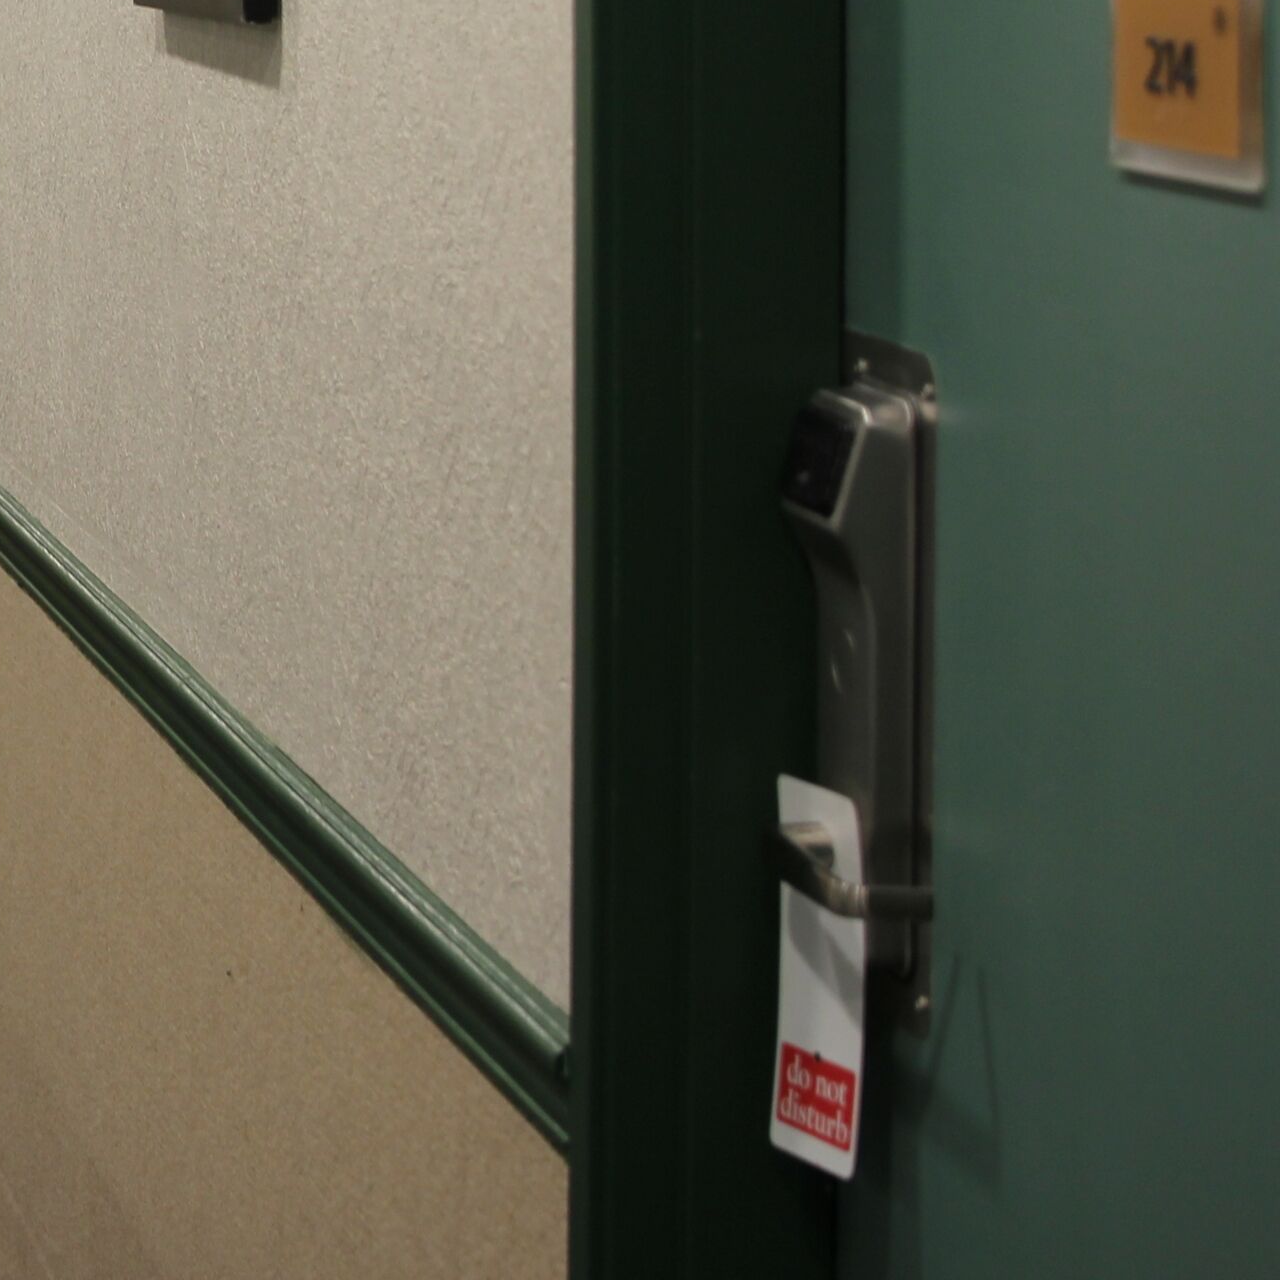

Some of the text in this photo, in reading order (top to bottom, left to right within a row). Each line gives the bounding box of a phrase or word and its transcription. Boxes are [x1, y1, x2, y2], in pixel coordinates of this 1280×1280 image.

[1144, 35, 1198, 100] 214
[787, 1053, 847, 1108] do not
[781, 1087, 848, 1144] disturb
